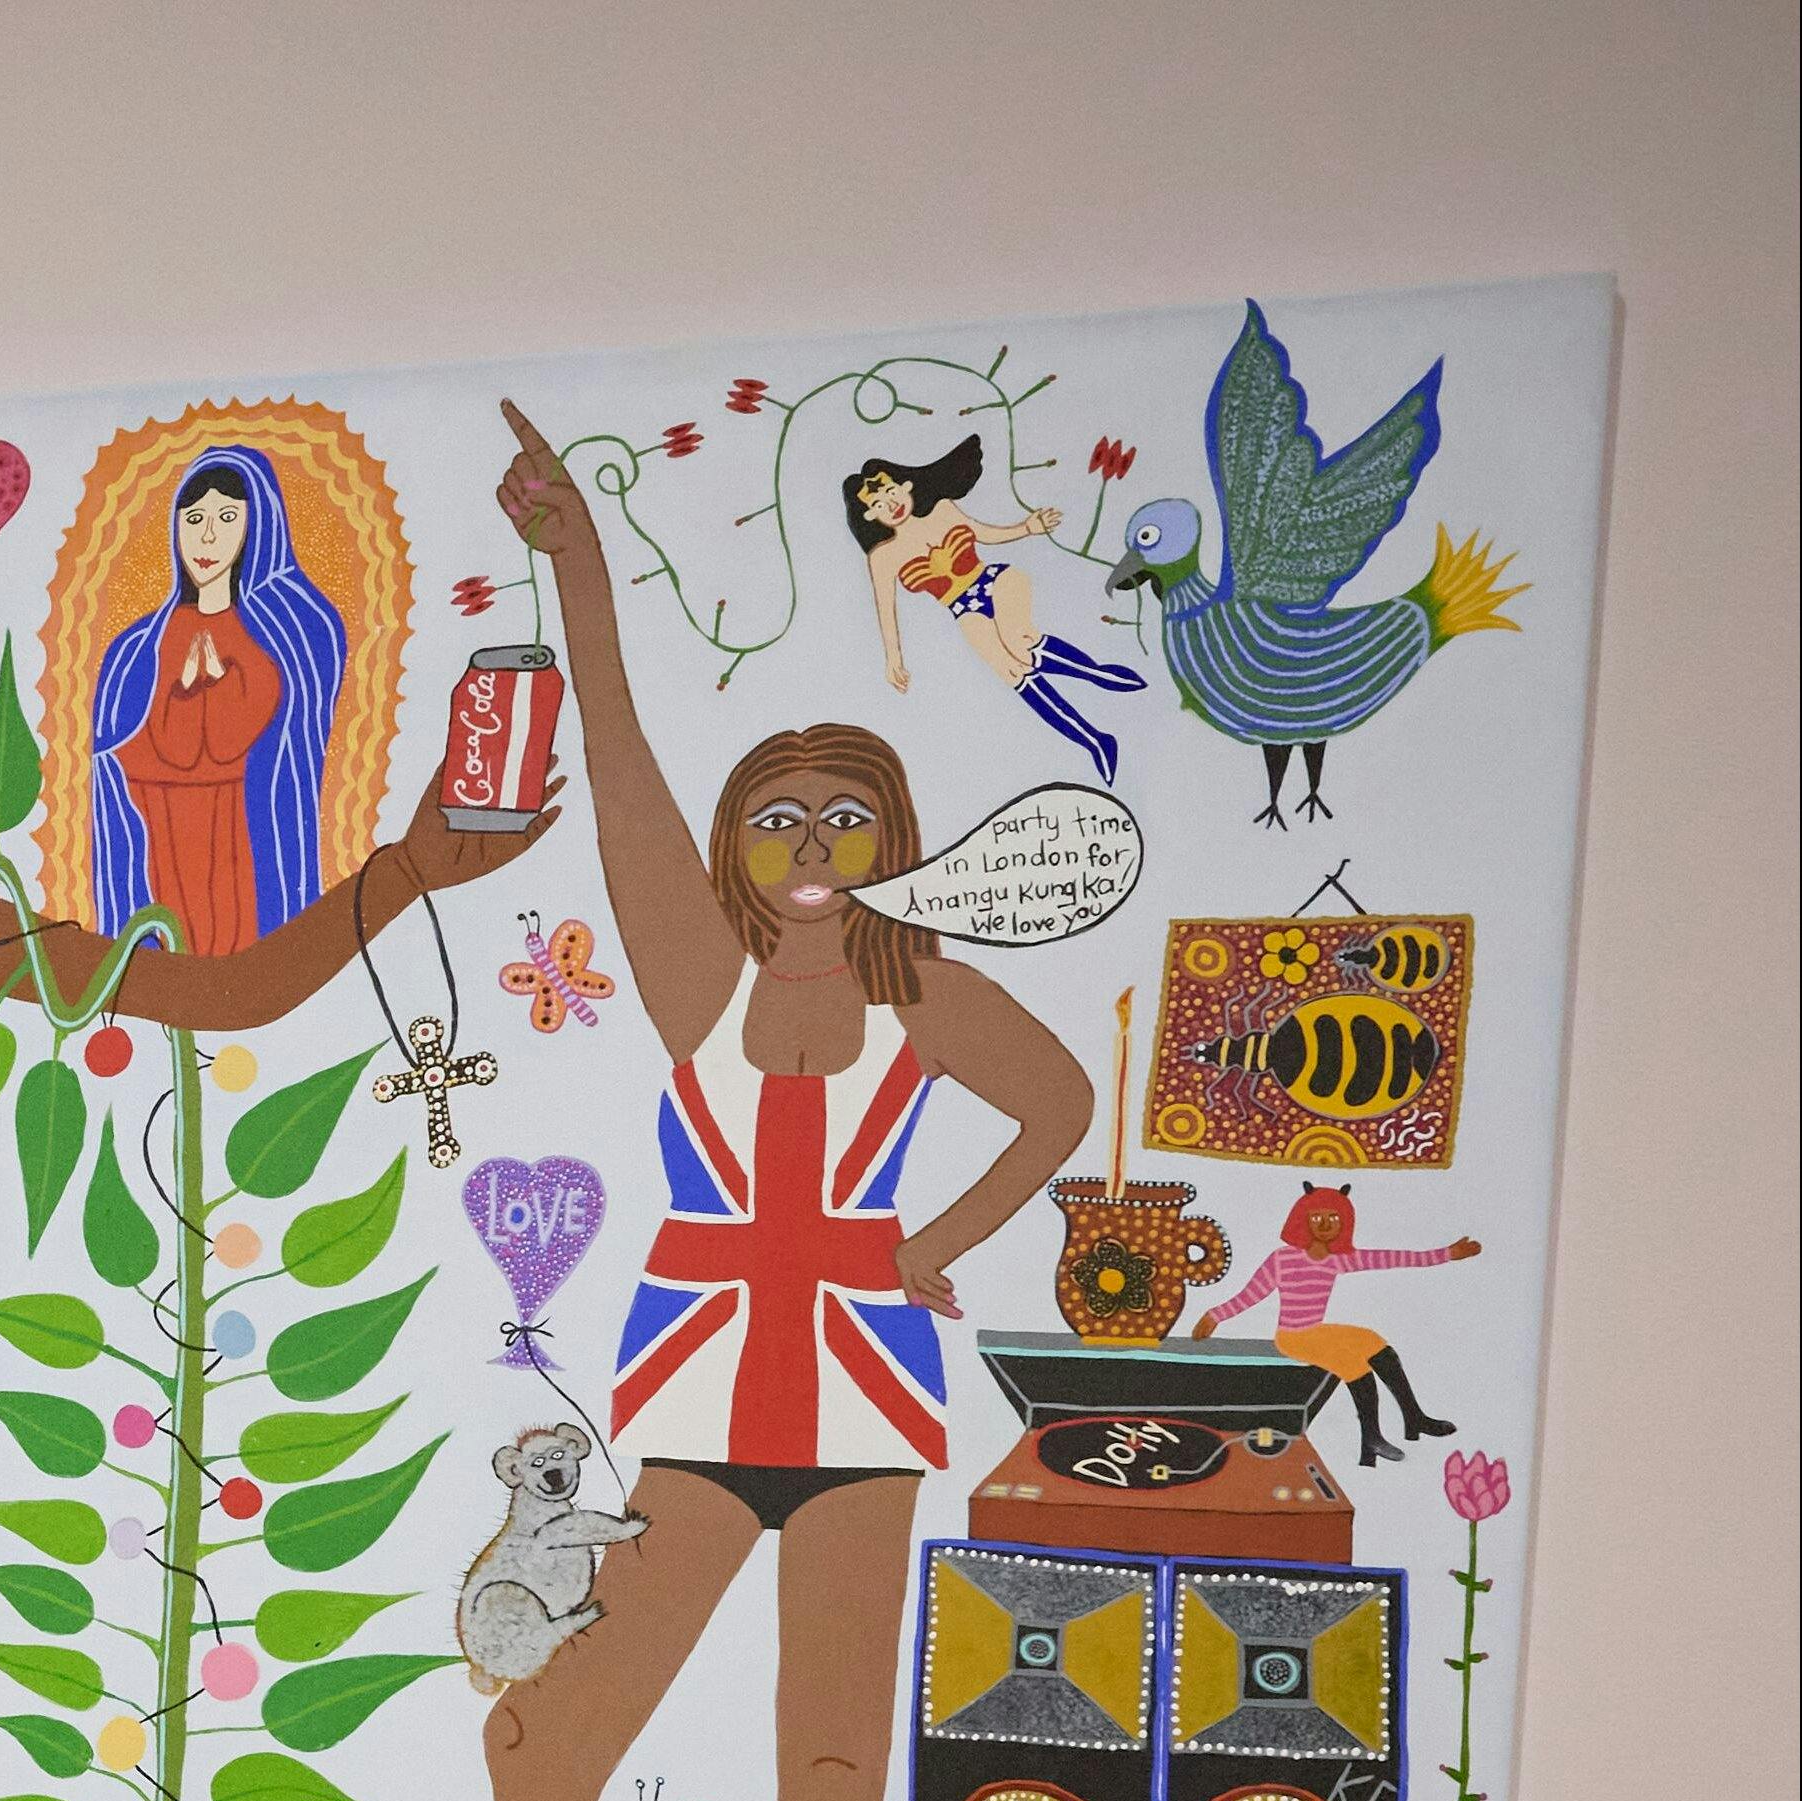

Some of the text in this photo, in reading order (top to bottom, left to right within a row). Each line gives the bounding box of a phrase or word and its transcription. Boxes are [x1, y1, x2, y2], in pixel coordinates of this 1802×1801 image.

[992, 805, 1133, 843] party time
[946, 839, 1132, 875] in London for
[903, 886, 1008, 918] Anangu
[971, 902, 1103, 935] We love you
